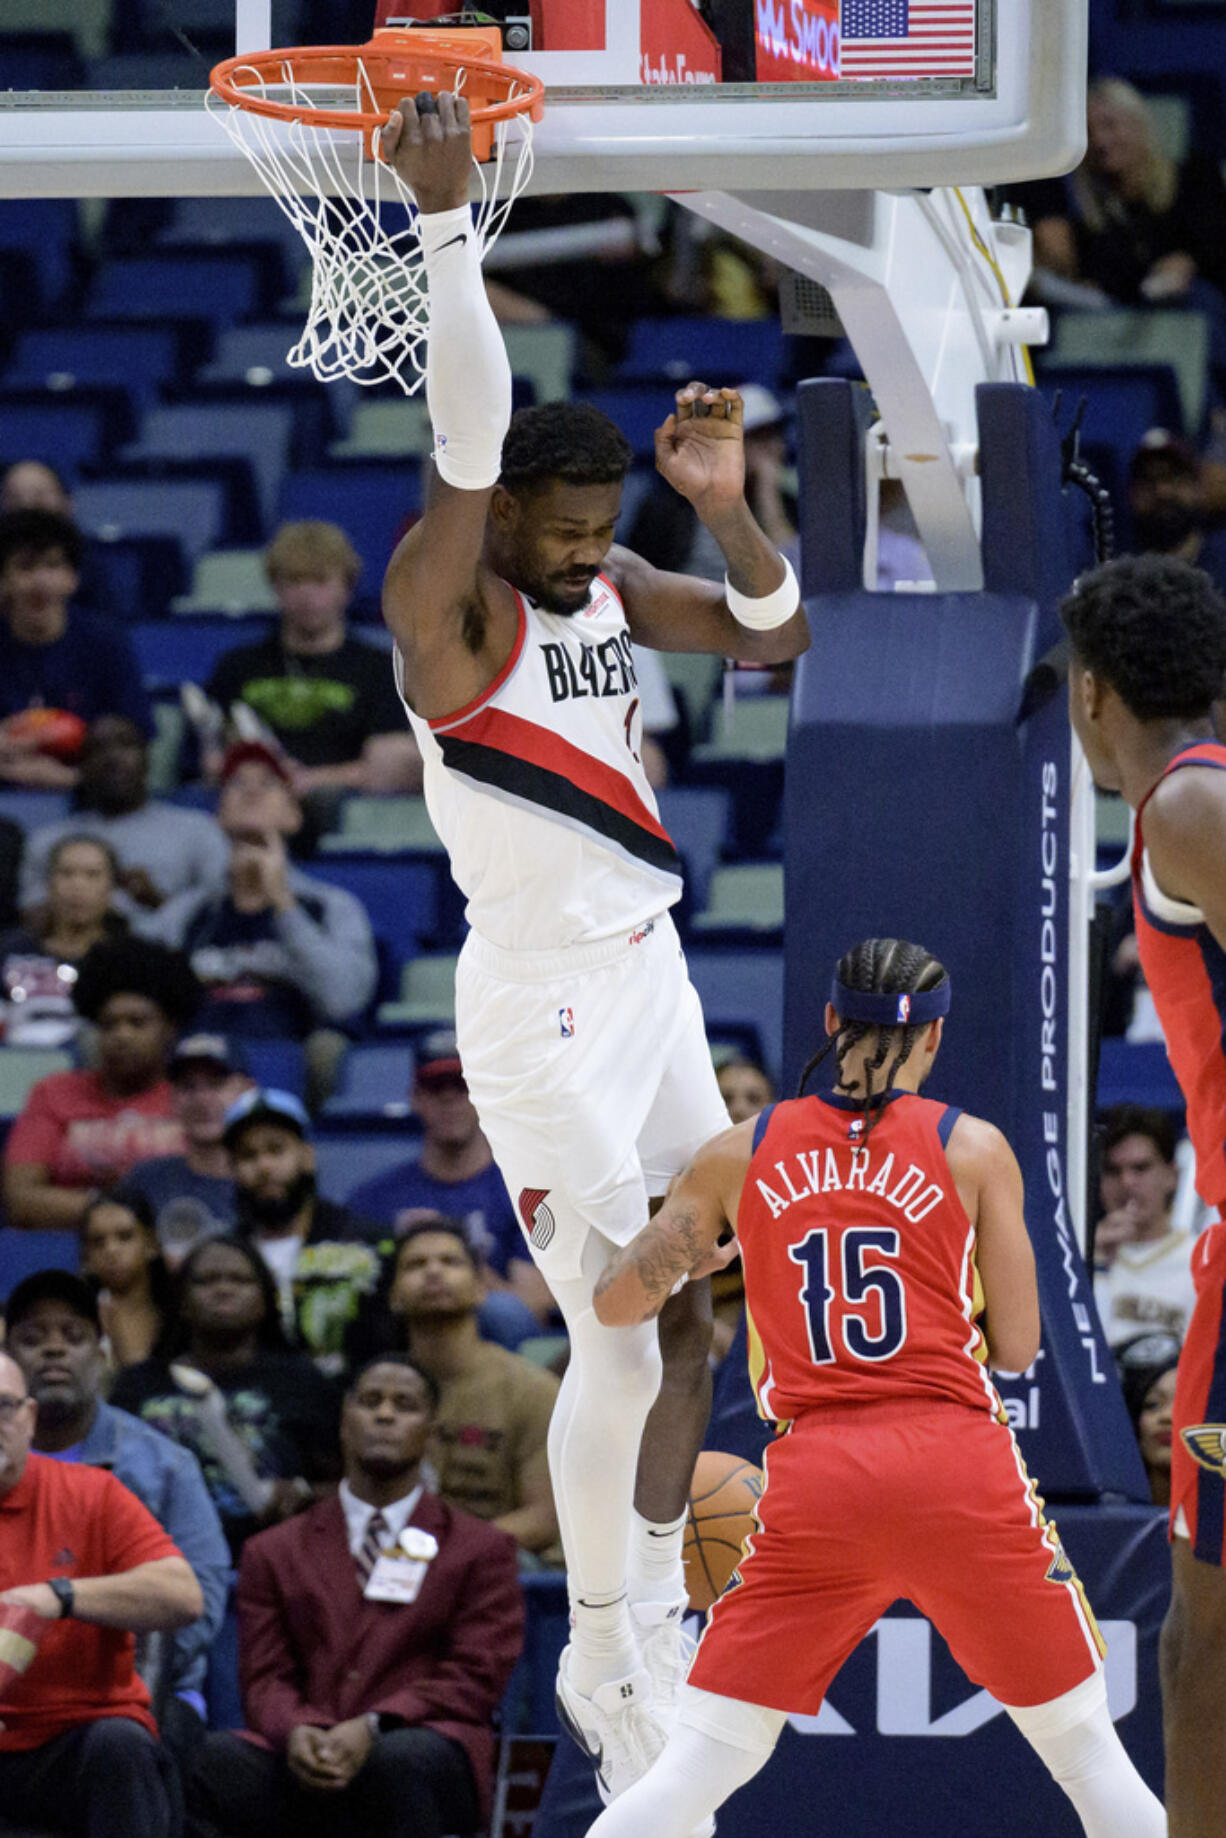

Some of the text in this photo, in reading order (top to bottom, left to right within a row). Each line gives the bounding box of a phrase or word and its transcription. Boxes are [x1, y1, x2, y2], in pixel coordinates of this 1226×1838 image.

[1041, 762, 1058, 1090] PRODUCTS
[756, 1147, 944, 1223] ALVARADO
[787, 1226, 907, 1365] 15
